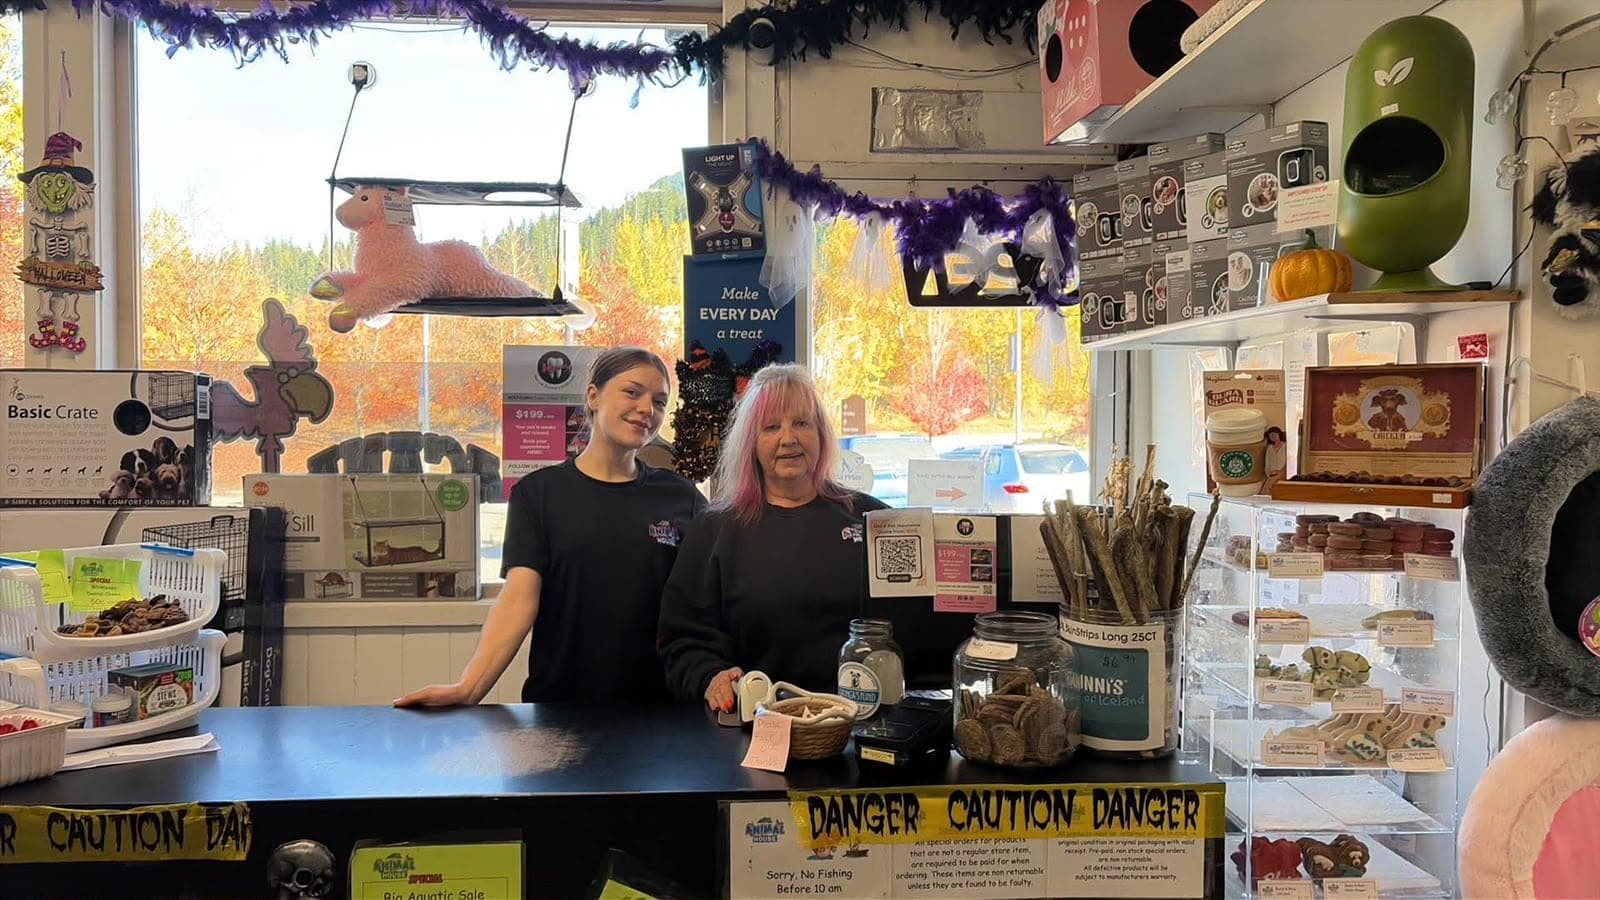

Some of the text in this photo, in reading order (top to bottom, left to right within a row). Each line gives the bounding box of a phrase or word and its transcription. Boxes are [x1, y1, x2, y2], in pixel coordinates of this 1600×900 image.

[34, 266, 88, 286] HALLOWEEN
[721, 287, 759, 300] Make
[700, 308, 779, 321] EVERY DAY
[717, 328, 763, 339] a treat
[8, 405, 99, 419] Basic Crate
[292, 515, 314, 532] Sill
[1102, 631, 1128, 643] Long
[1132, 631, 1156, 642] 25CT
[157, 689, 177, 701] STEWS
[1100, 695, 1145, 706] Iceland
[808, 788, 1200, 840] DANGER CAUTION DANGER
[47, 808, 188, 853] CAUTION
[745, 820, 785, 835] ANIMAL
[927, 839, 951, 848] special
[994, 837, 1026, 845] products
[910, 850, 926, 858] that
[942, 849, 954, 857] not
[962, 848, 989, 857] regular
[991, 847, 1010, 855] store
[925, 860, 957, 869] required
[980, 858, 995, 867] paid
[1011, 857, 1030, 865] when
[766, 869, 853, 881] Sorry, No Fishing
[931, 870, 953, 878] These
[955, 869, 976, 877] items
[1006, 867, 1044, 876] returnable
[777, 883, 842, 894] Before 10 am
[908, 882, 930, 890] unless
[932, 880, 949, 890] they
[965, 880, 986, 888] found
[459, 888, 485, 900] Sale
